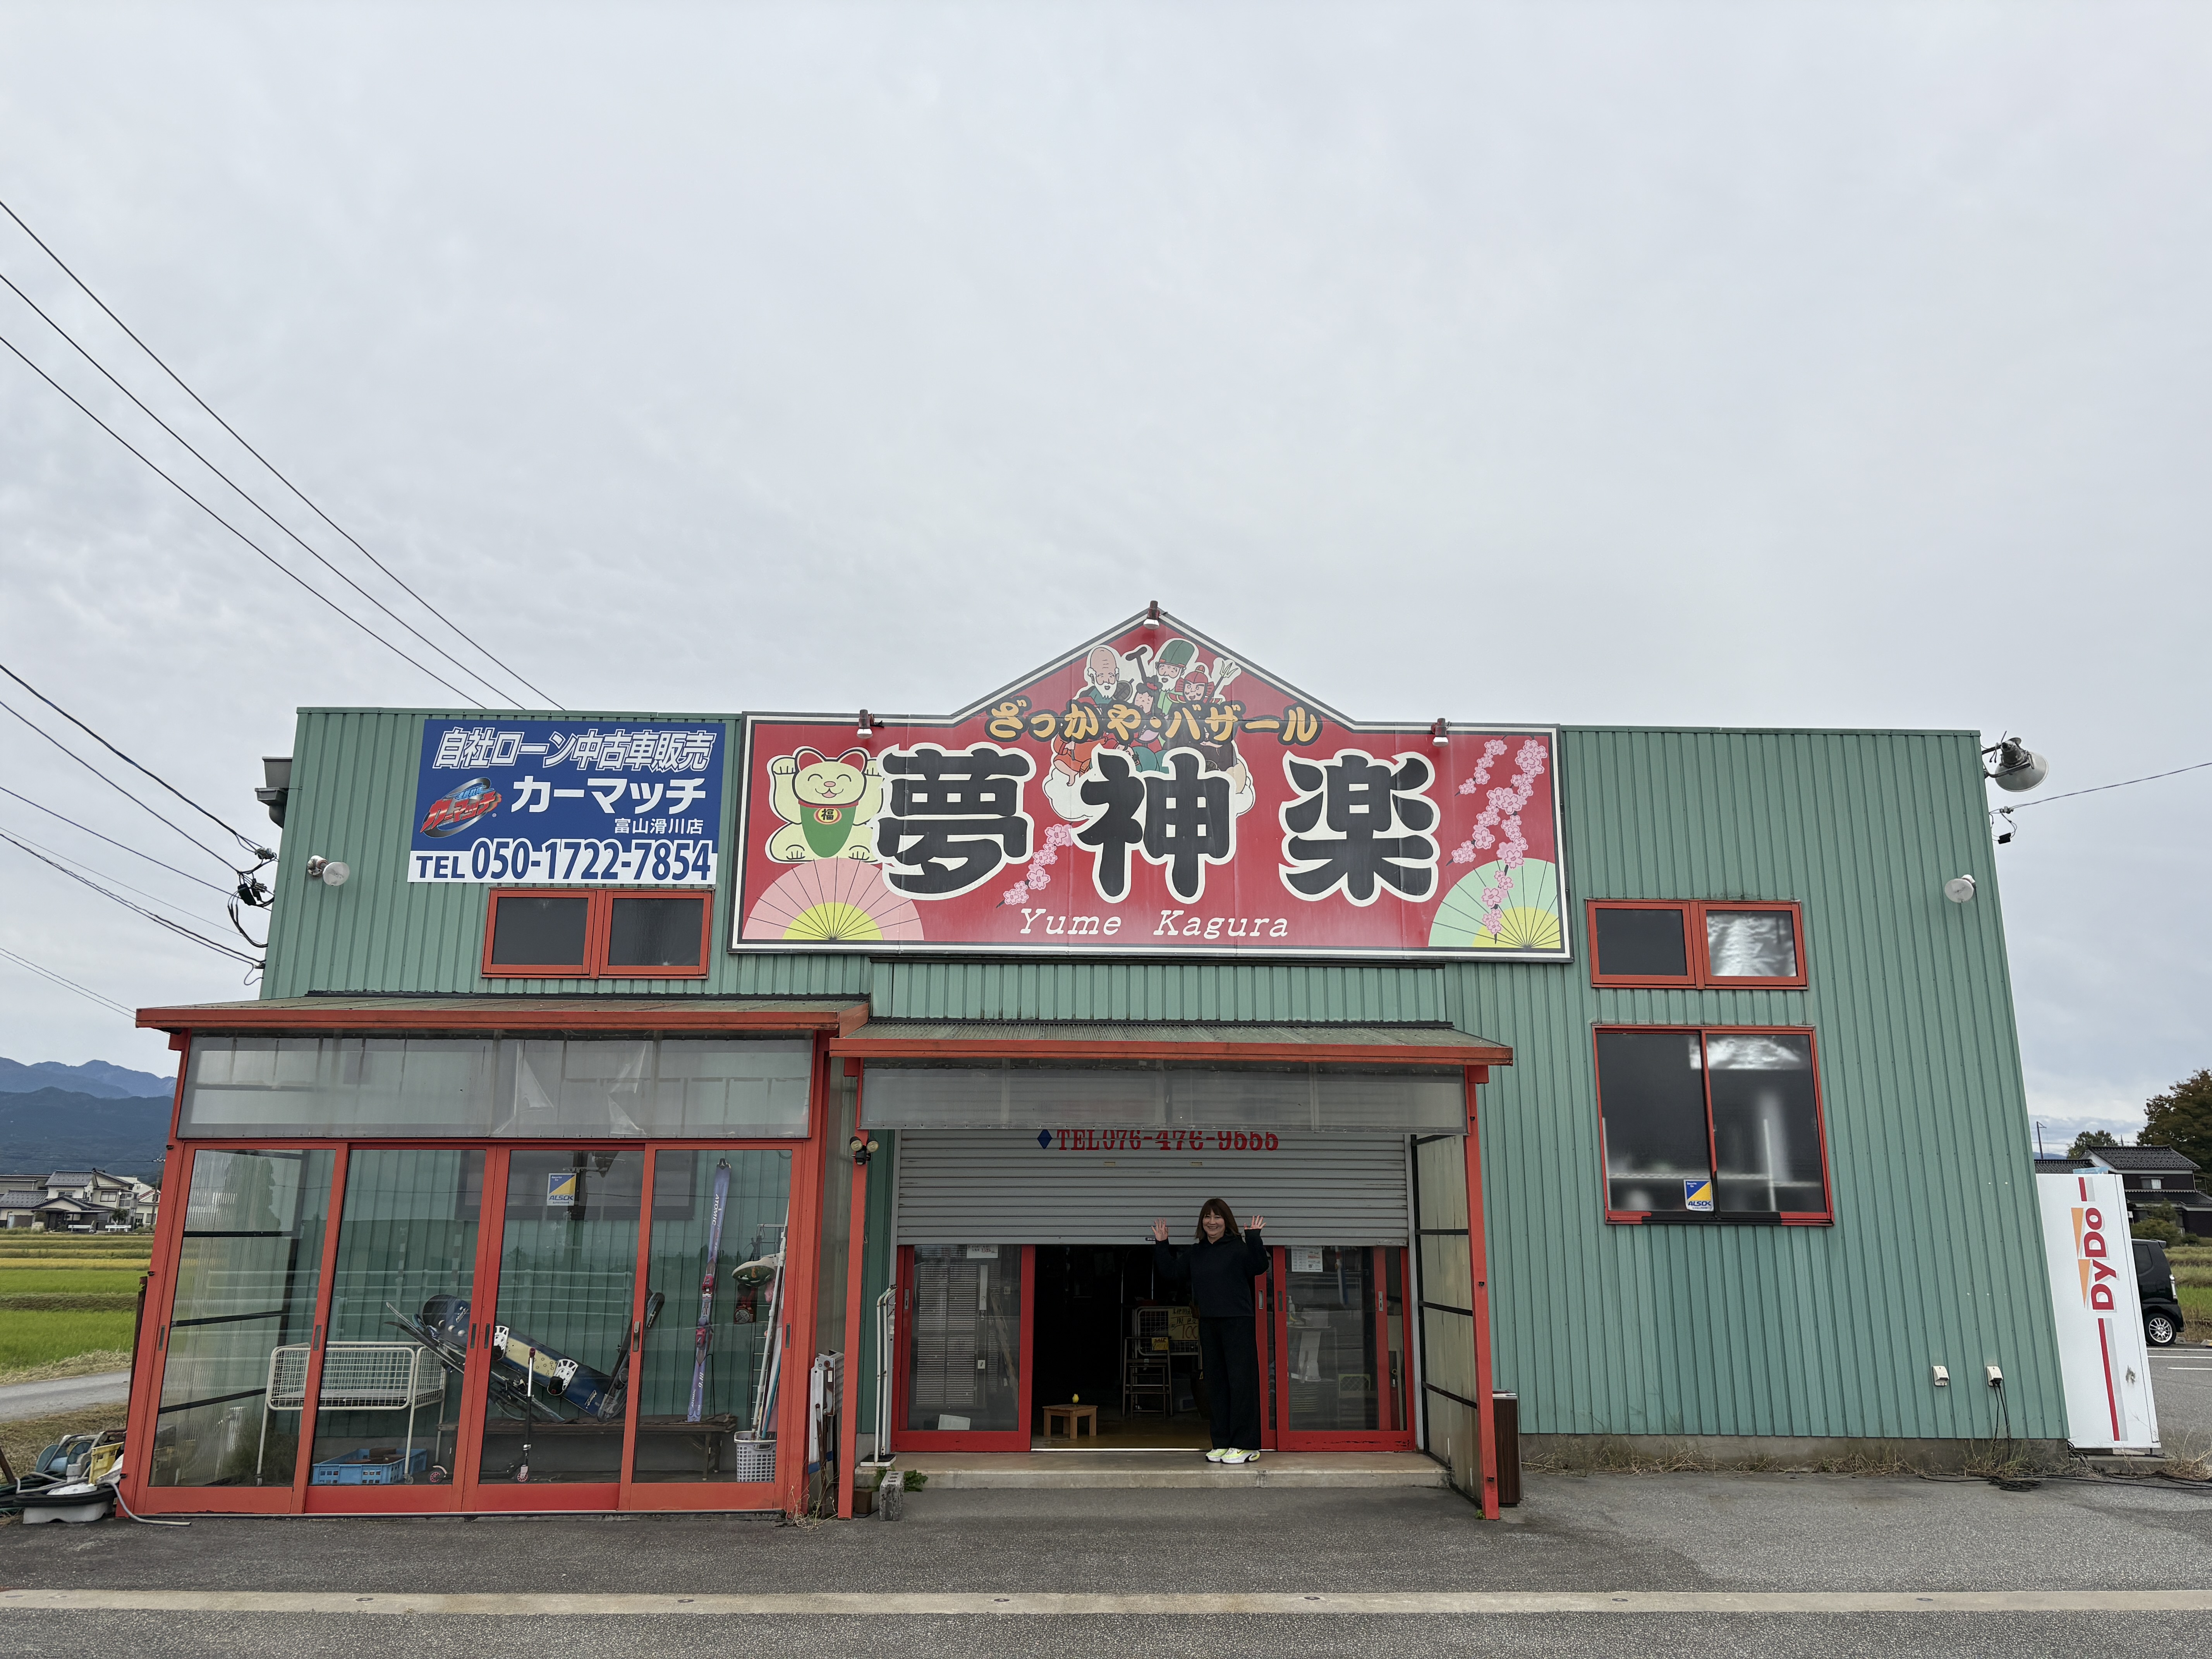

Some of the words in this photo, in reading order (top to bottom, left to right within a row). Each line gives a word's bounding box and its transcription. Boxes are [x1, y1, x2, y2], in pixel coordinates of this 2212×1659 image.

[990, 701, 1317, 742] ざっかや・バザール
[433, 726, 716, 772] 自社ローン中古車販売
[511, 776, 706, 815] カーマッチ
[821, 809, 834, 821] 福
[614, 818, 704, 835] 富山滑川店
[877, 747, 1434, 901] 夢神楽
[416, 856, 465, 879] TEL
[471, 840, 711, 881] 050-1722-7854
[1020, 908, 1121, 935] Yume
[1153, 910, 1288, 940] Kagura
[2084, 1207, 2118, 1310] DyDo
